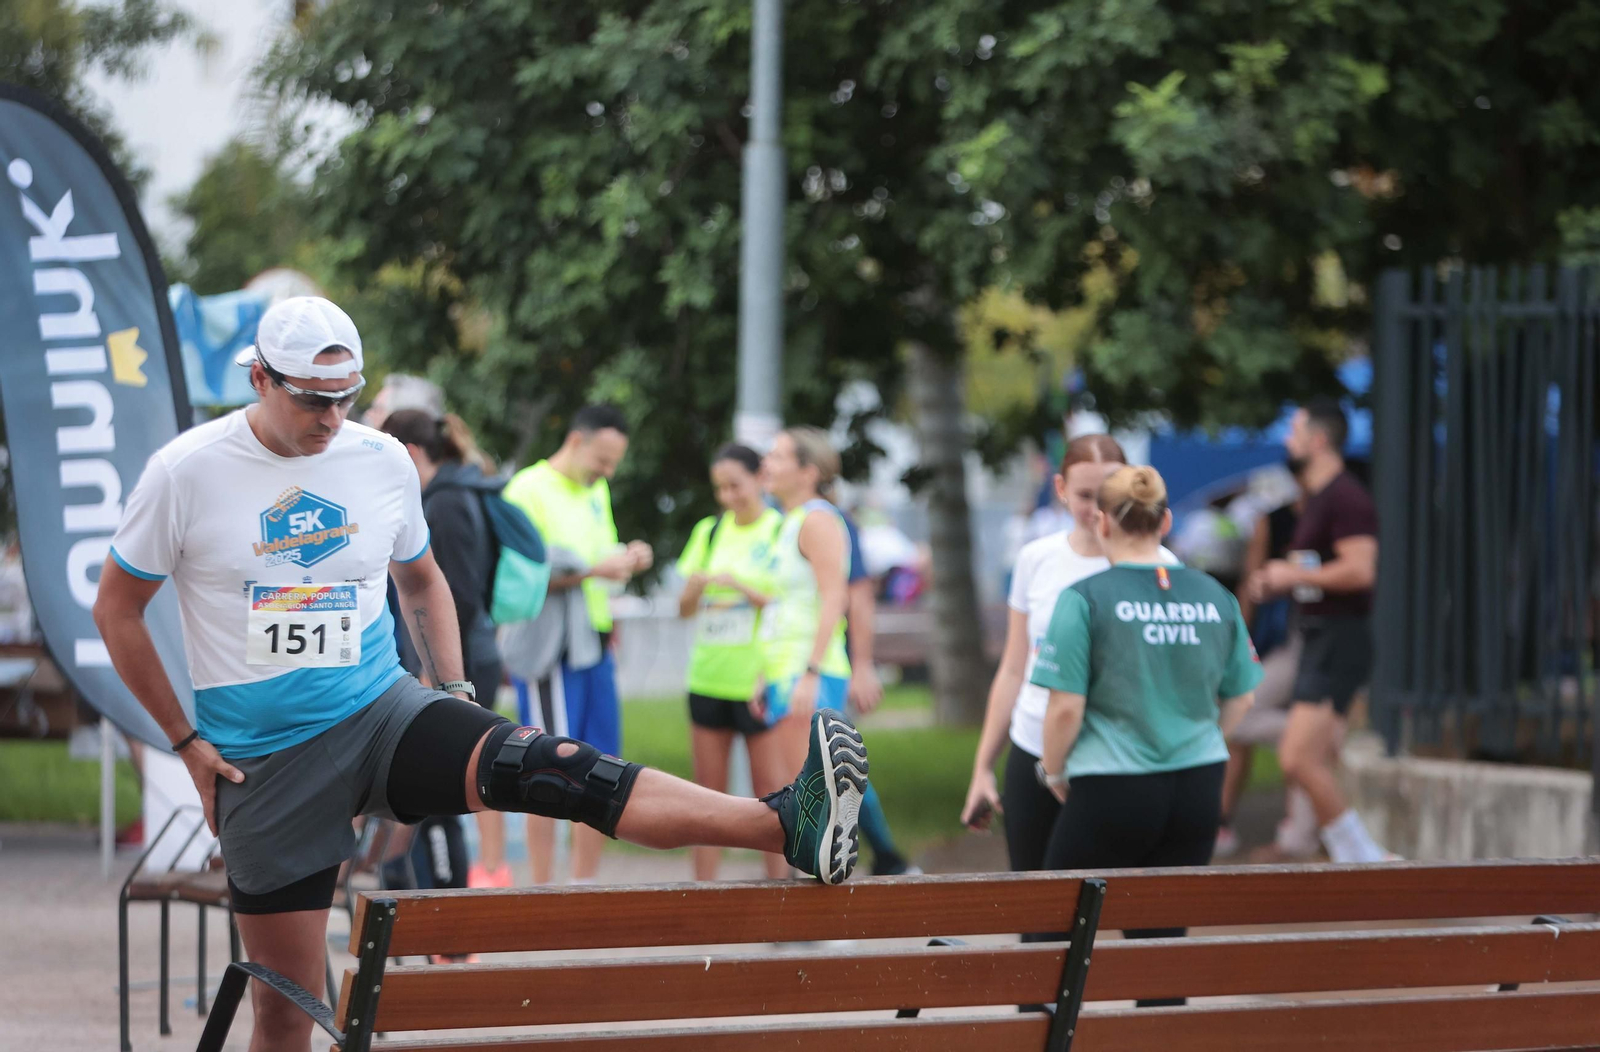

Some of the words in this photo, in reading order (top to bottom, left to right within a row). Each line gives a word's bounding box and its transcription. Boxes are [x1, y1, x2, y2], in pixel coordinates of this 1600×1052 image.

[289, 508, 325, 535] 5K
[252, 522, 359, 557] Valdelagrana
[265, 548, 302, 568] 2025
[260, 591, 308, 601] CARRERA
[310, 591, 351, 600] POPULAR
[1115, 600, 1221, 623] GUARDIA
[264, 623, 327, 655] 151
[1143, 624, 1200, 645] CIVIL
